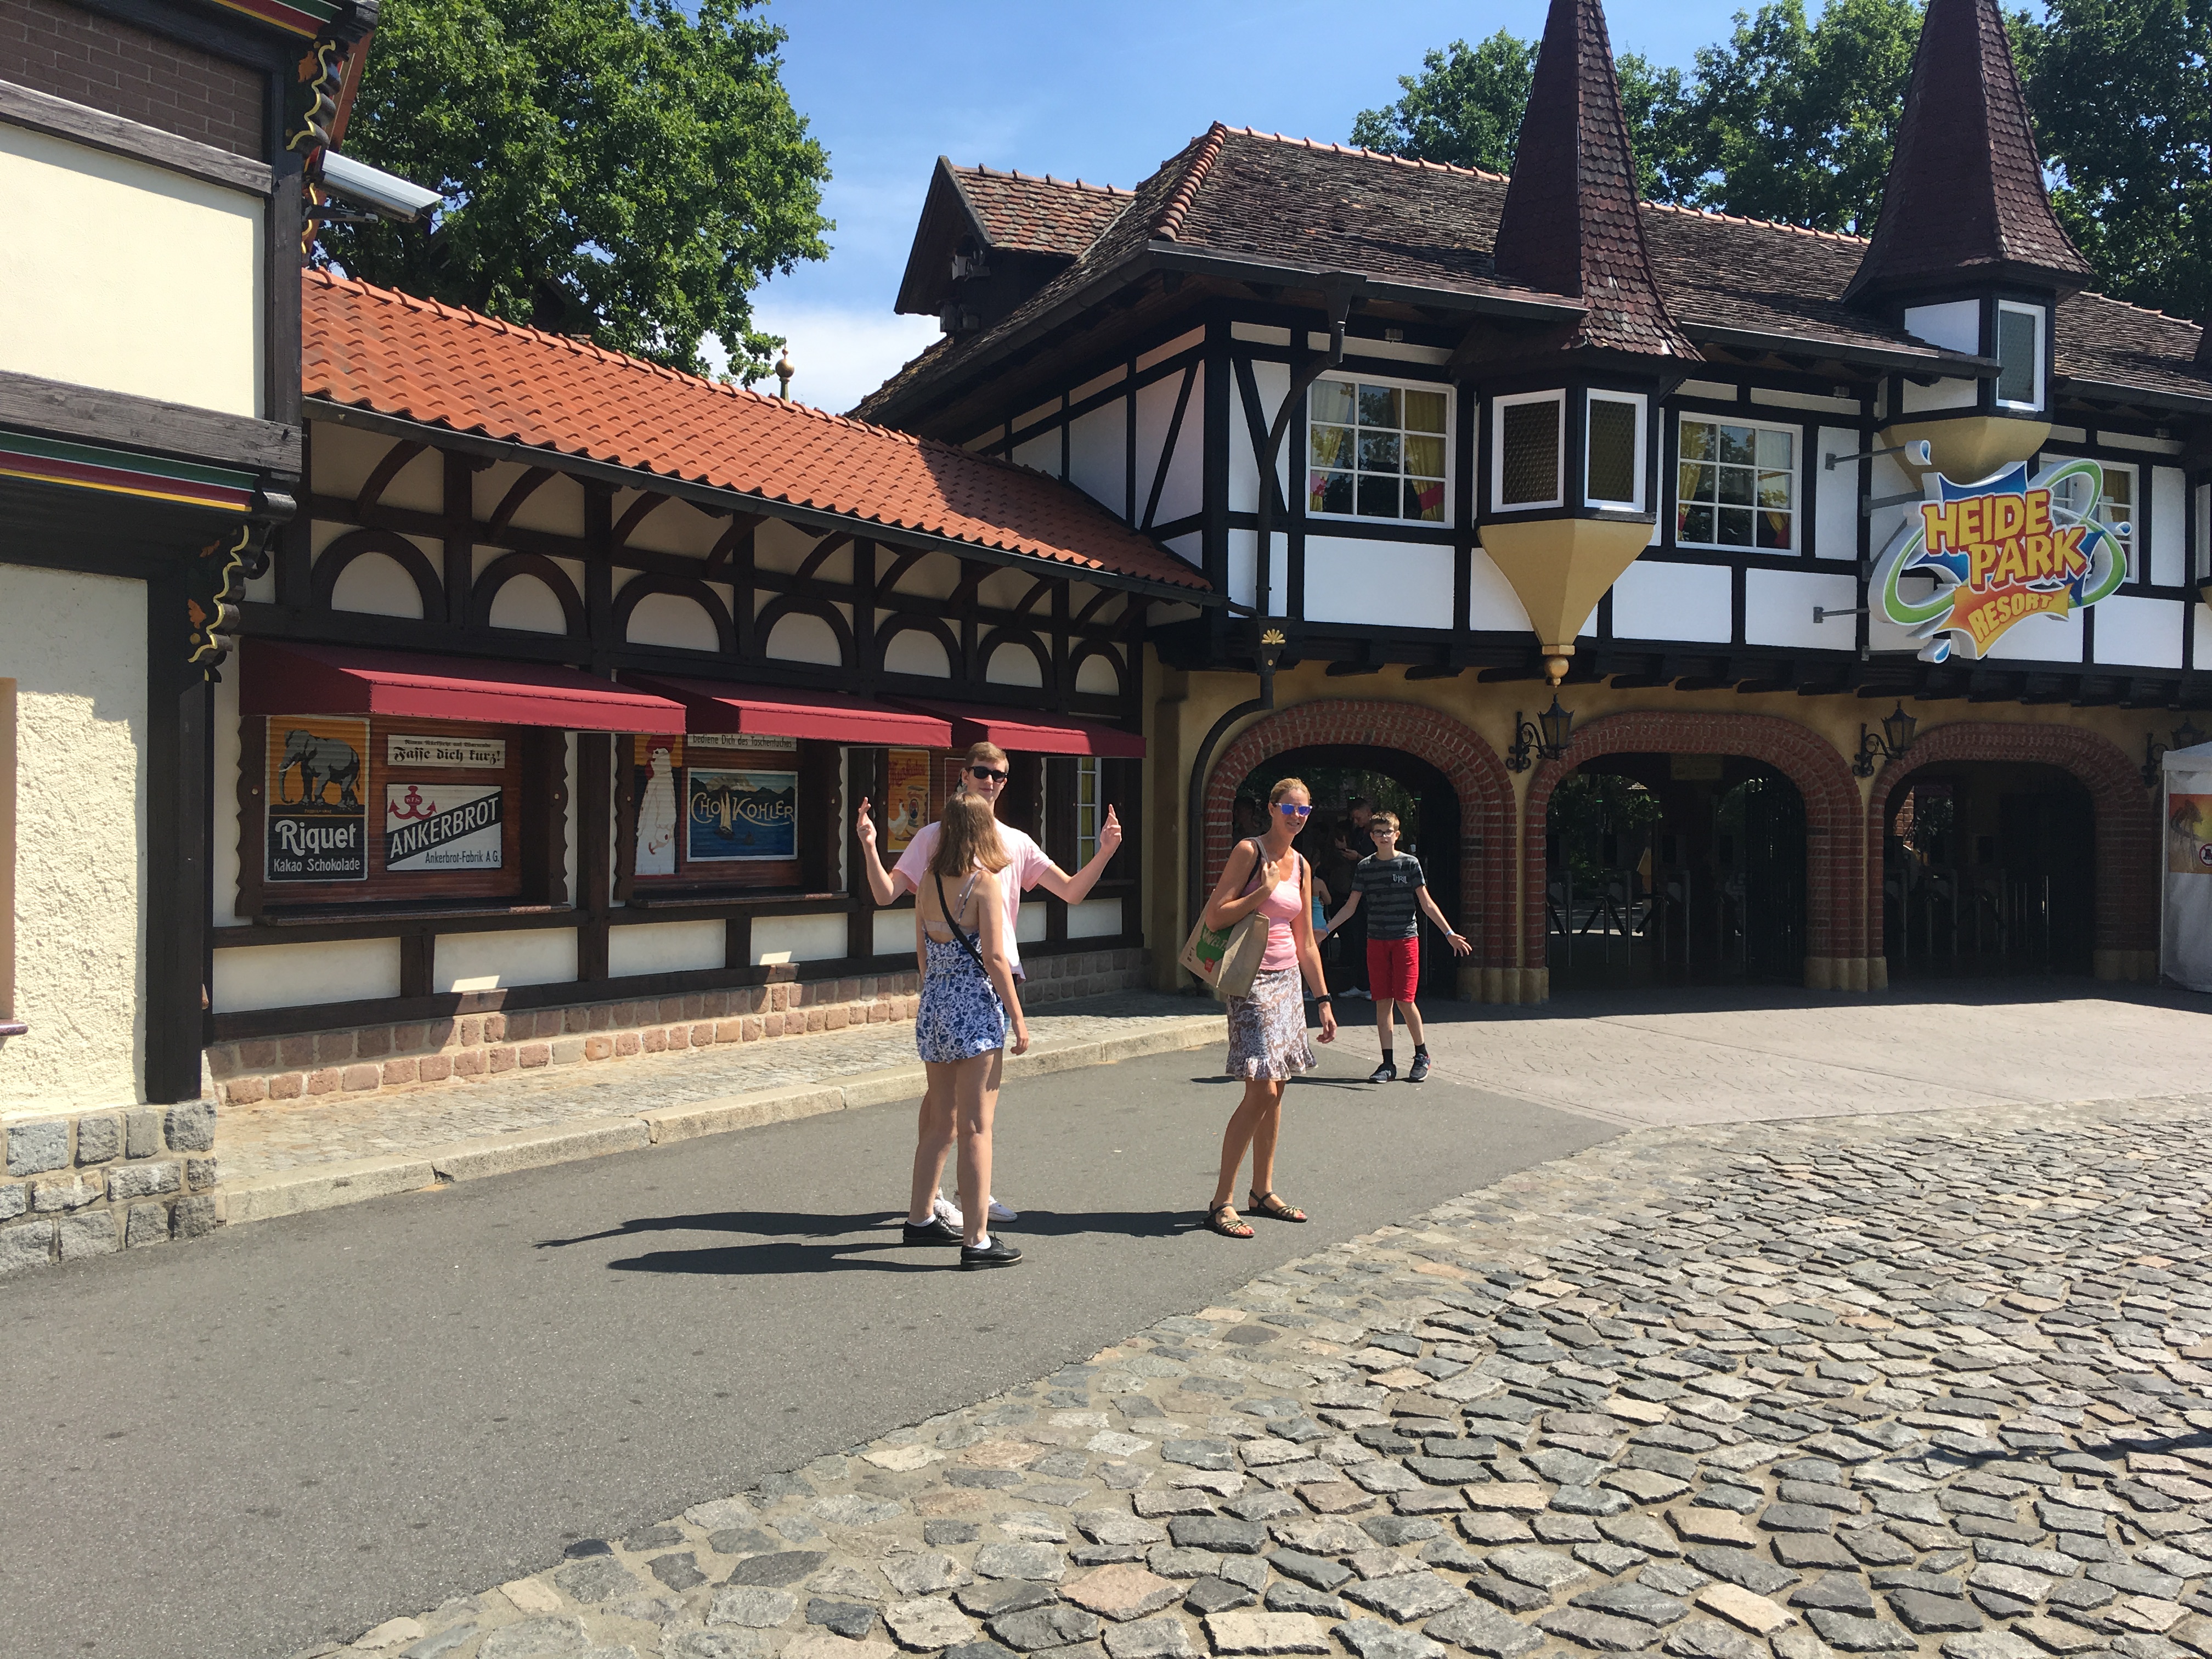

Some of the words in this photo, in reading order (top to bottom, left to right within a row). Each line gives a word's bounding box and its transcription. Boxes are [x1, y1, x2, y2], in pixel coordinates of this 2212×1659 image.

[1921, 488, 2052, 556] HEIDE
[1967, 526, 2088, 592] PARK
[1967, 593, 2053, 644] RESORT
[693, 733, 719, 744] bediene
[721, 735, 735, 745] Dich
[737, 735, 748, 746] des
[436, 748, 464, 763] dich
[469, 749, 501, 765] kurz!
[390, 797, 499, 859] ANKERBROT
[732, 797, 795, 827] KOHLER
[275, 820, 357, 856] Riquet
[274, 859, 302, 872] Kakao
[307, 857, 360, 871] Schokolade
[425, 850, 483, 864] Ankerbrot-Fabrik
